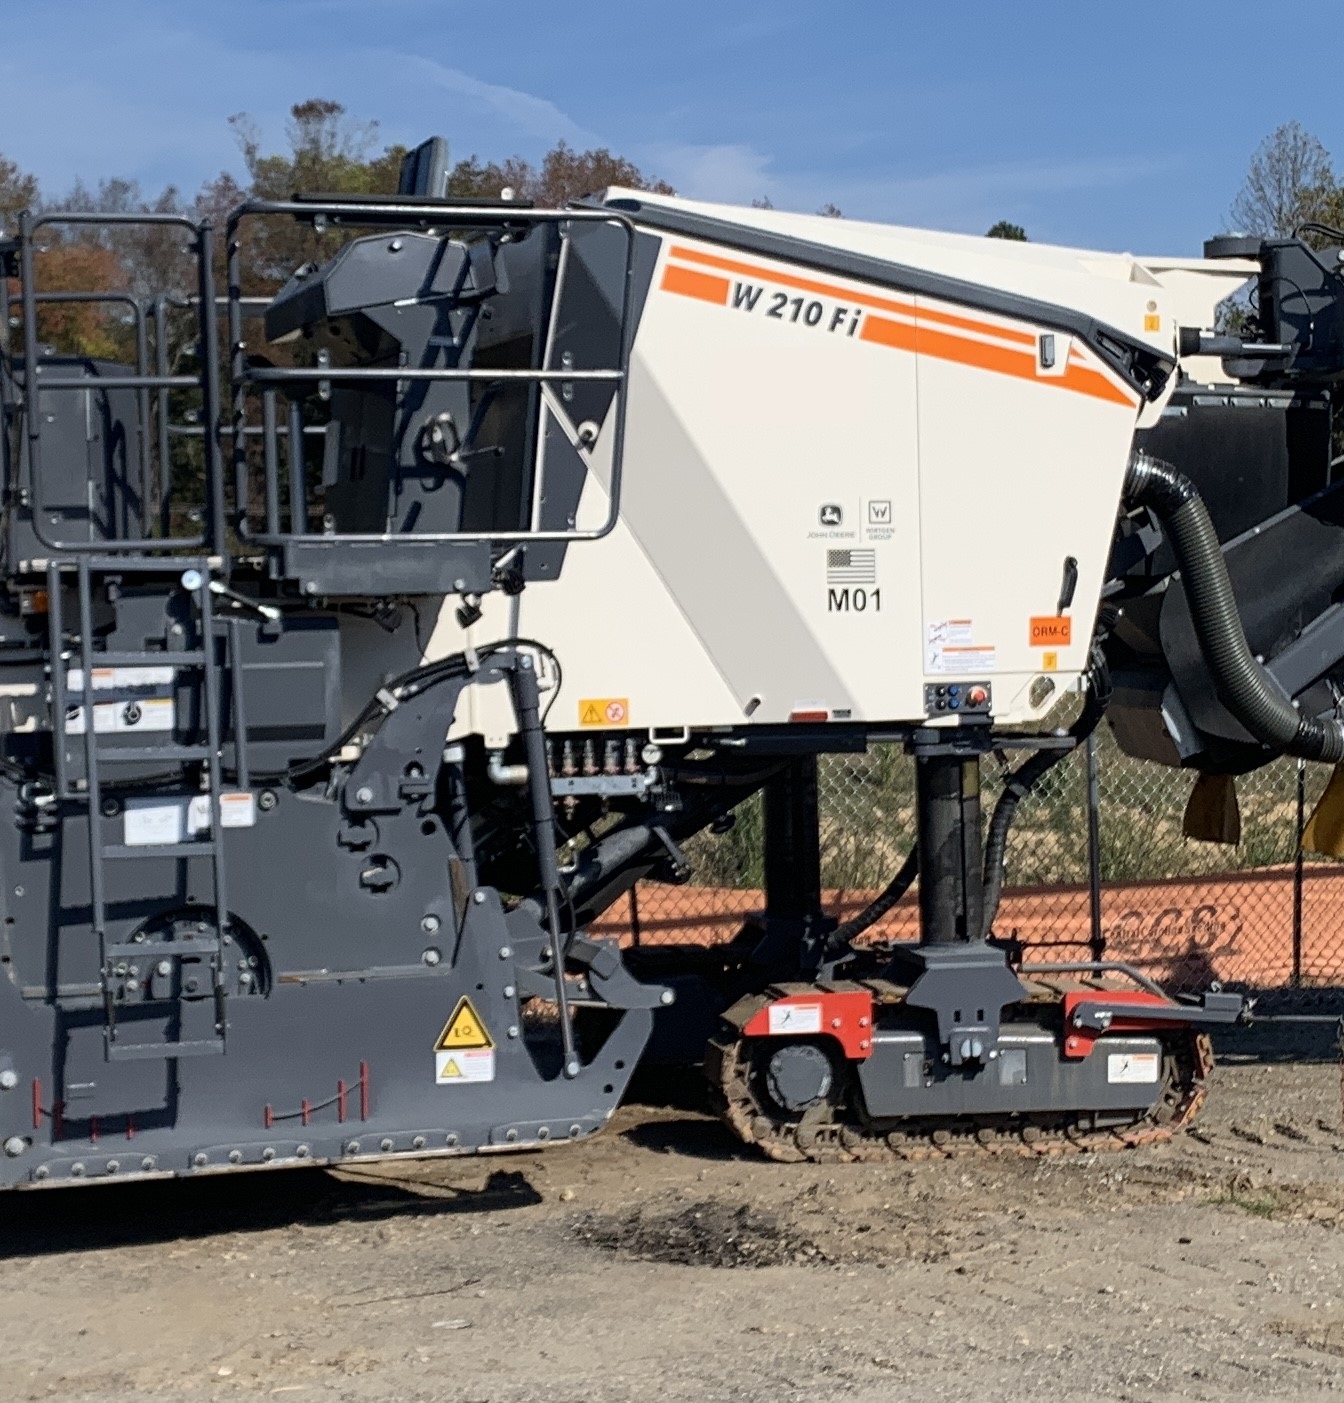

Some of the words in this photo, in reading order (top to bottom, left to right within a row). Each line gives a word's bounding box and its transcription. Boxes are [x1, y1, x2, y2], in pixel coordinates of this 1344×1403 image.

[731, 281, 764, 313] W
[765, 292, 823, 327] 210
[827, 306, 862, 337] Fi
[807, 531, 828, 539] JOHN
[828, 588, 881, 612] M01
[1032, 626, 1069, 637] ORM-C
